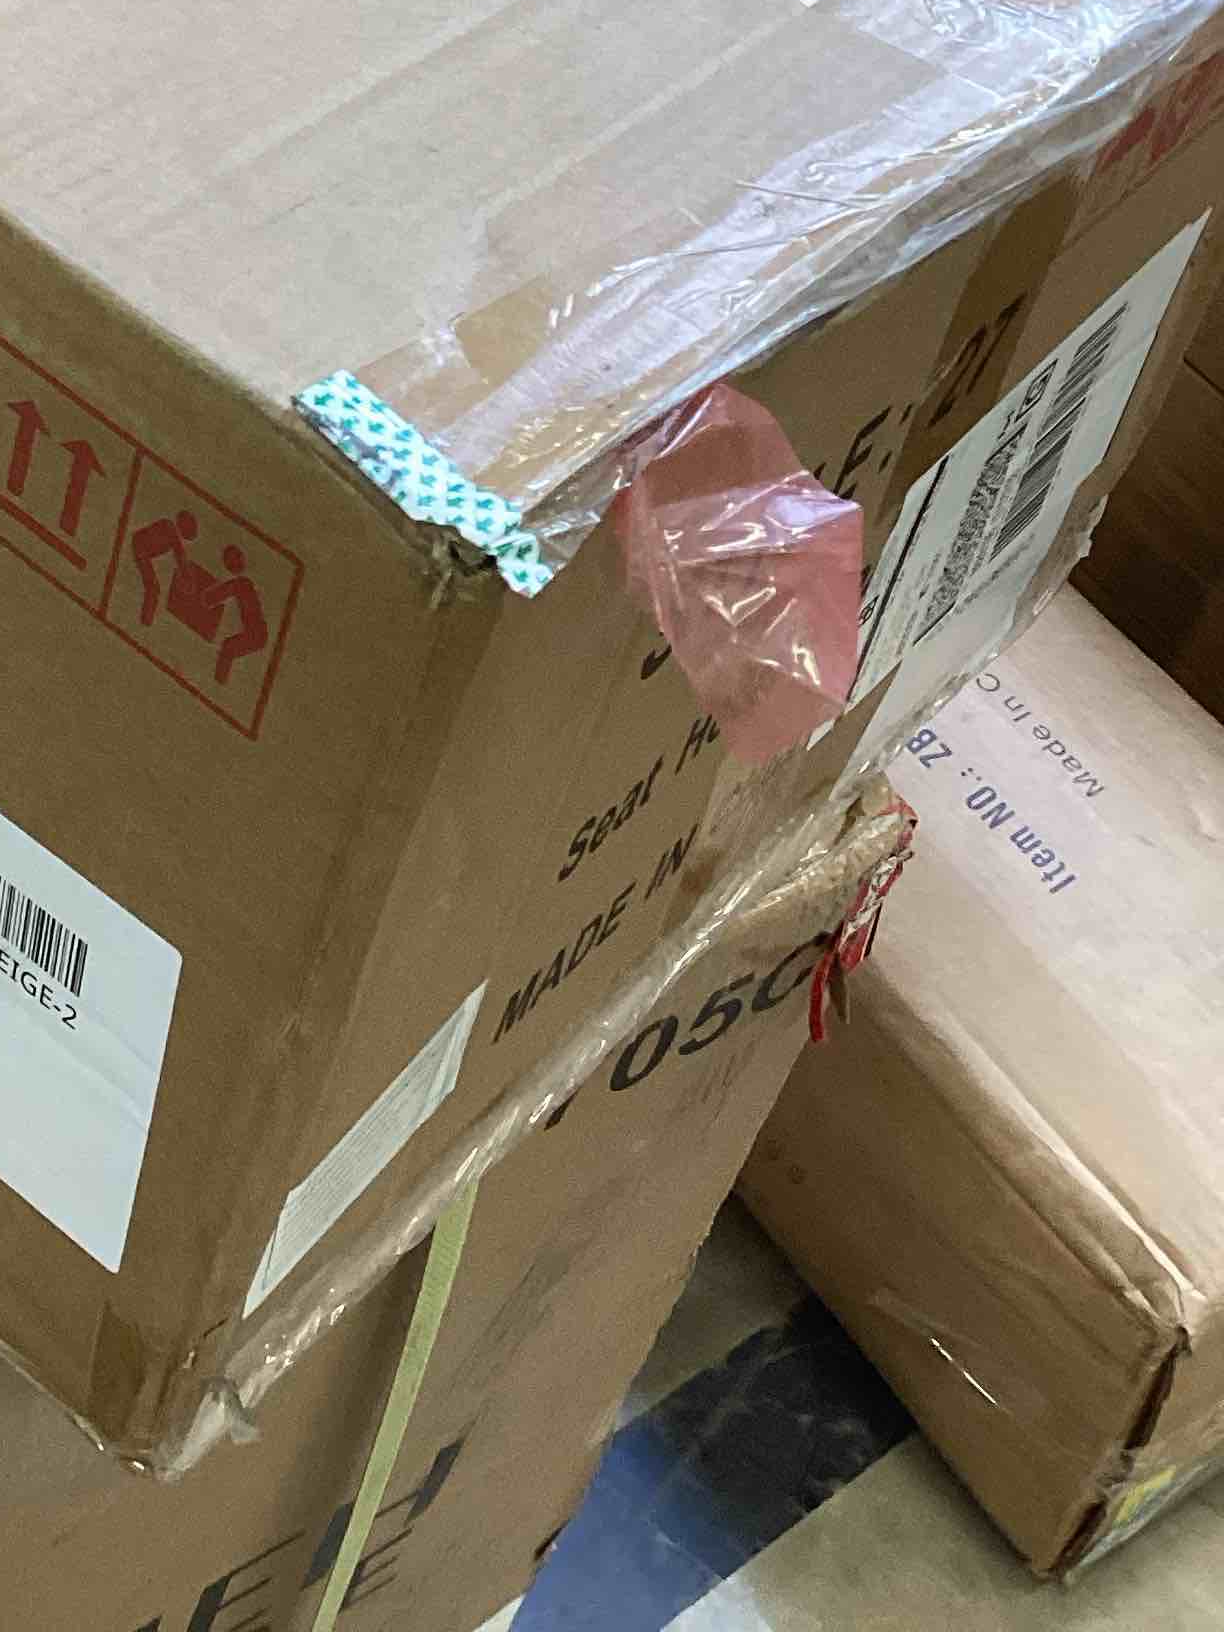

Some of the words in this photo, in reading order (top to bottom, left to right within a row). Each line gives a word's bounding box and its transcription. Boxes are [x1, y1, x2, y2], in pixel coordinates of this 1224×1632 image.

[1004, 694, 1035, 723] In
[1032, 723, 1105, 799] Made
[1009, 825, 1079, 895] Item
[492, 881, 638, 1046] MADE
[645, 822, 700, 901] IN
